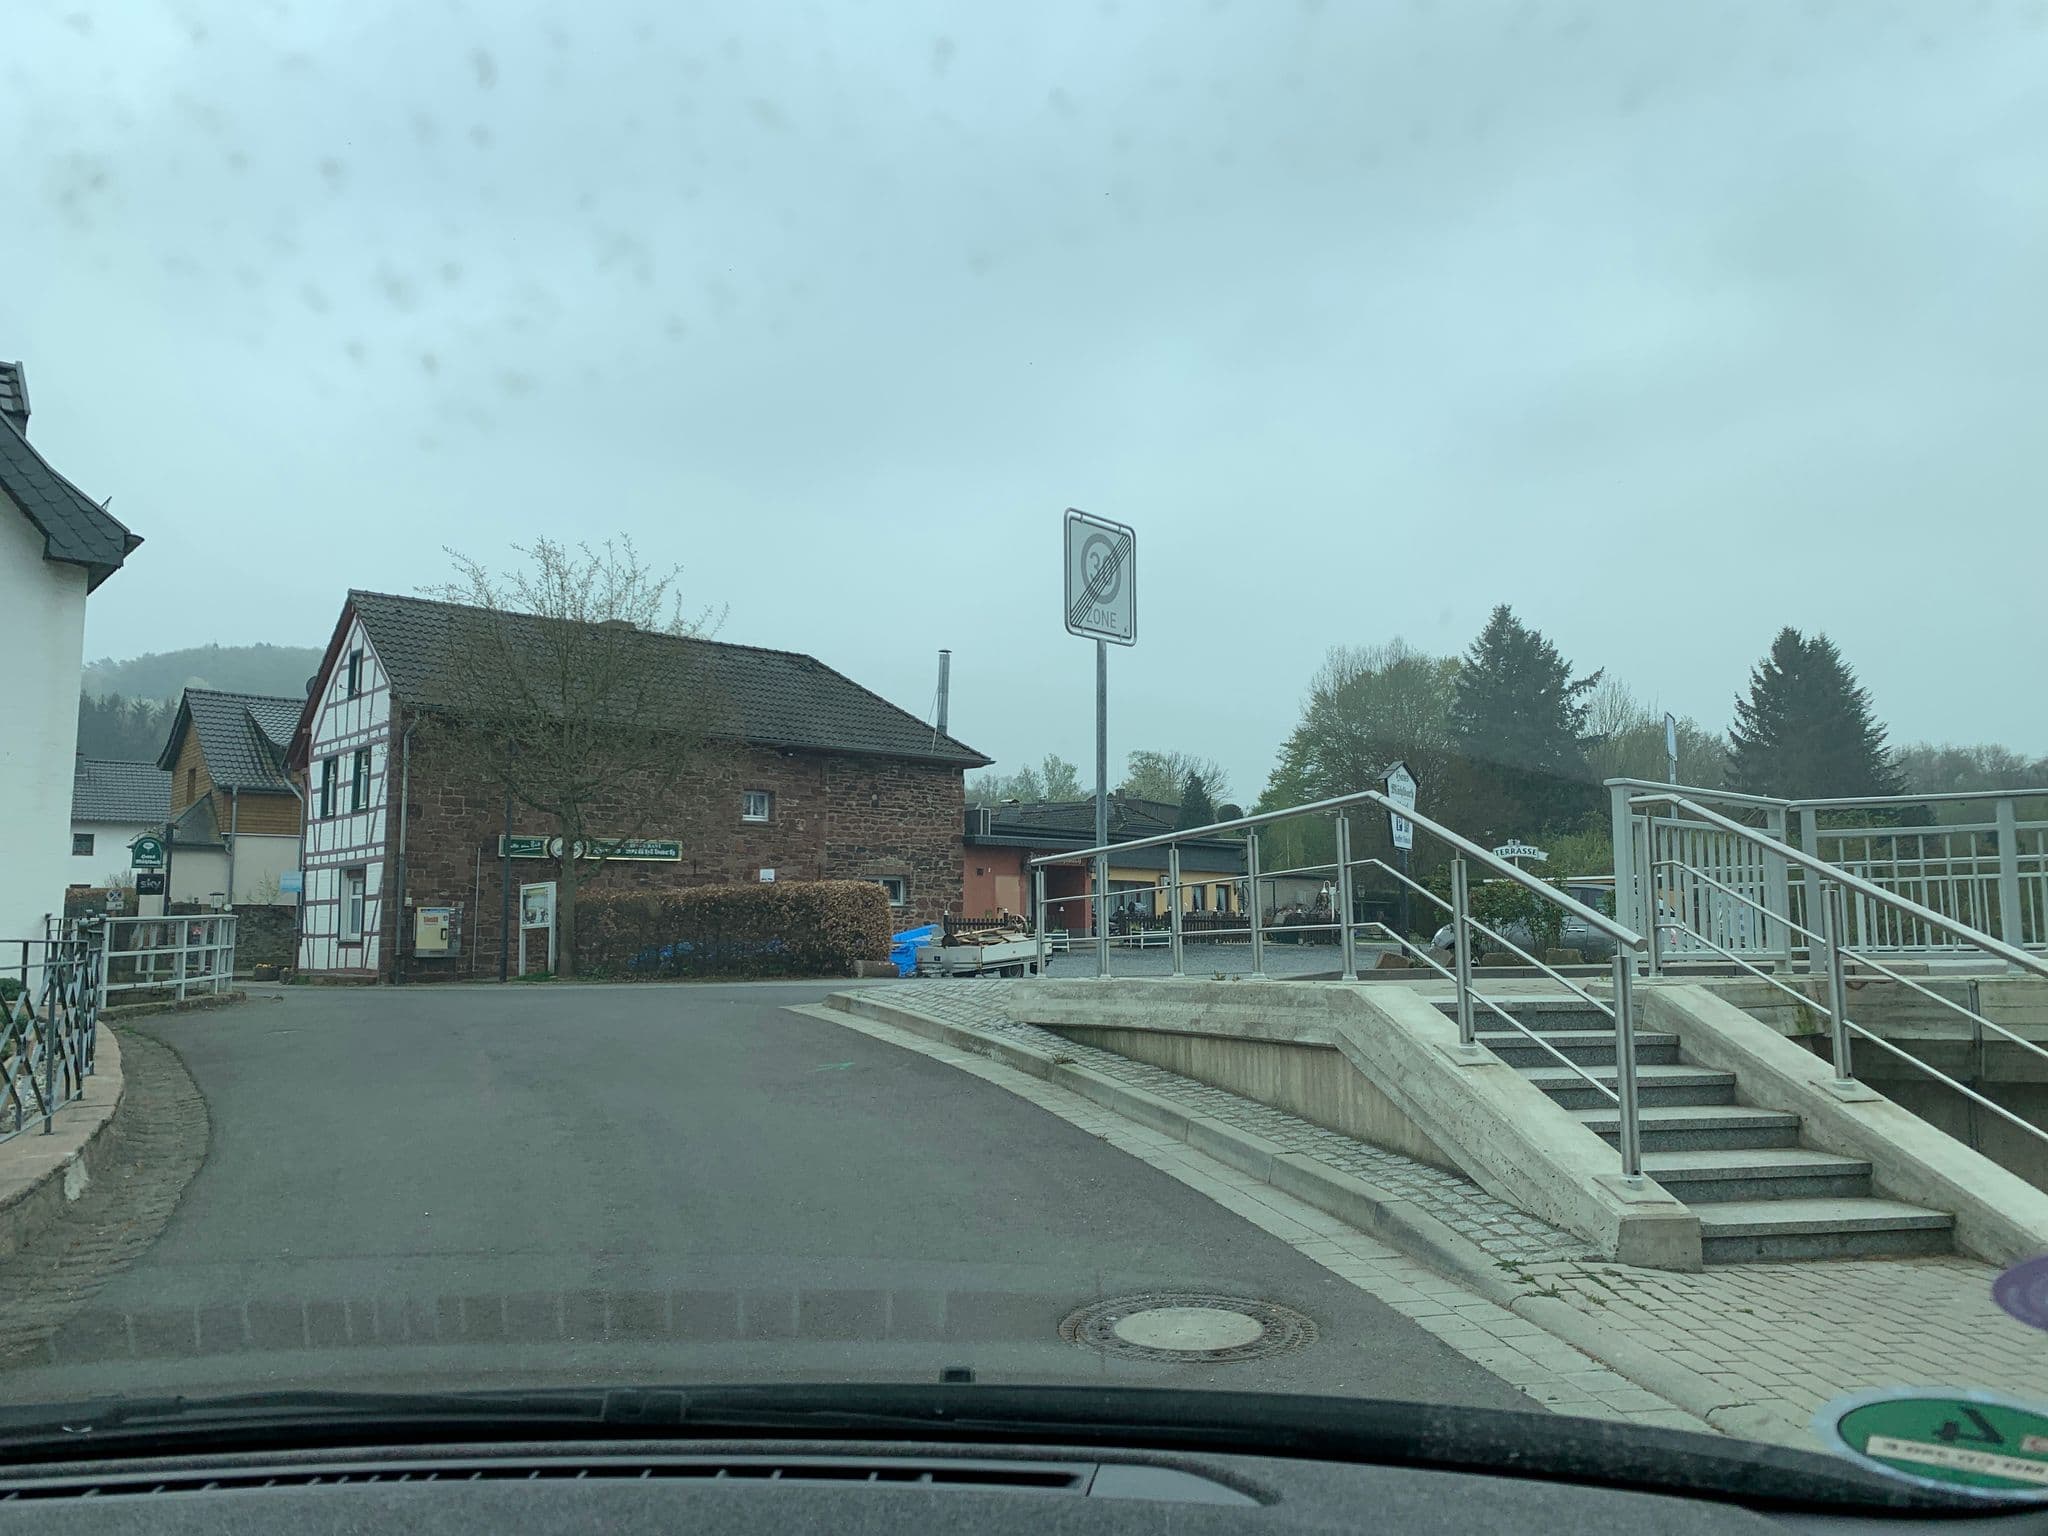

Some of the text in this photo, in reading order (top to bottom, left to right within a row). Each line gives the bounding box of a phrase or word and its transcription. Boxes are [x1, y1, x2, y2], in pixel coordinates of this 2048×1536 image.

[1086, 608, 1117, 628] ZONE
[1495, 847, 1537, 856] TERRASSE
[140, 878, 162, 890] sky
